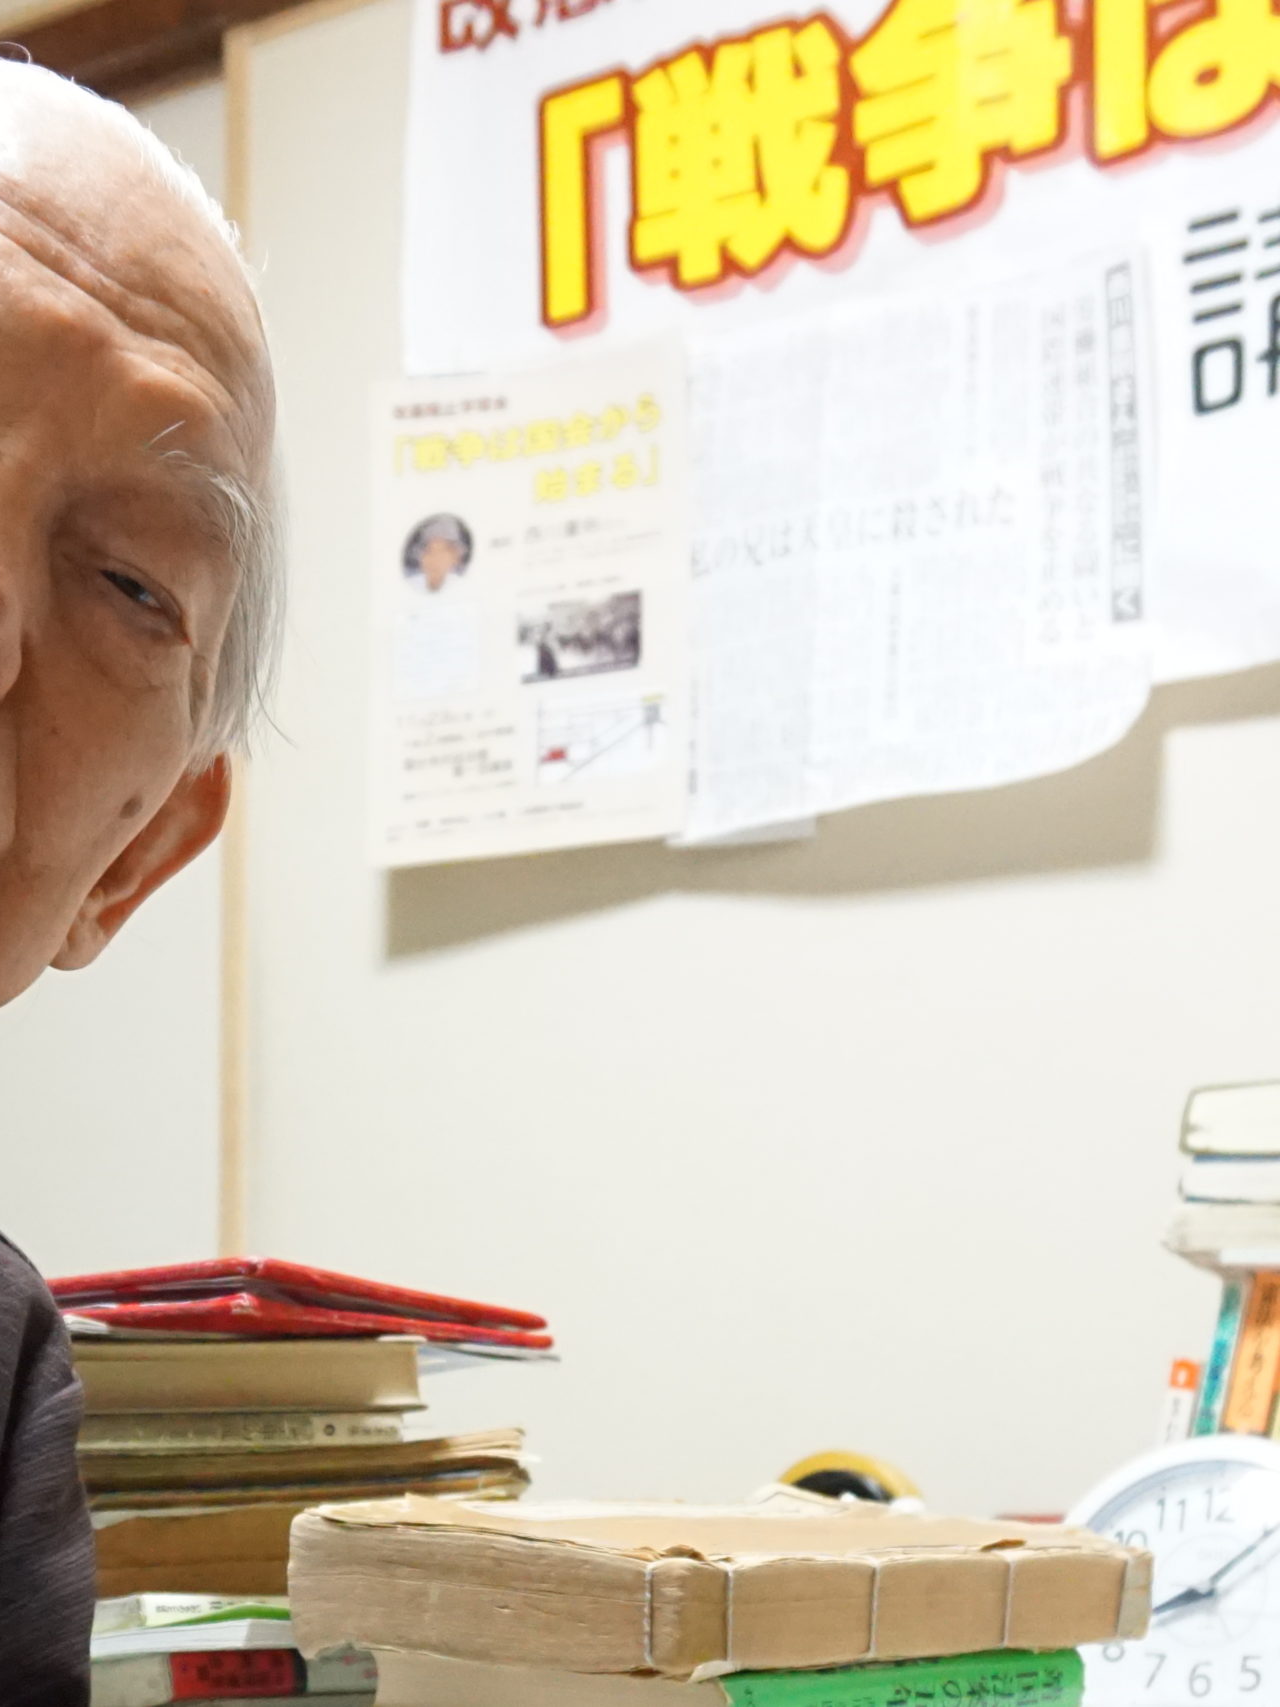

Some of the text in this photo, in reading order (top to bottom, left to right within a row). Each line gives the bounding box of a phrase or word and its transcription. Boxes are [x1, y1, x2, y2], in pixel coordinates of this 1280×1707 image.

[1157, 1496, 1187, 1533] 11
[1204, 1485, 1236, 1524] 12
[1144, 1651, 1167, 1690] 7
[1188, 1660, 1212, 1698] 6
[1239, 1654, 1263, 1692] 5
